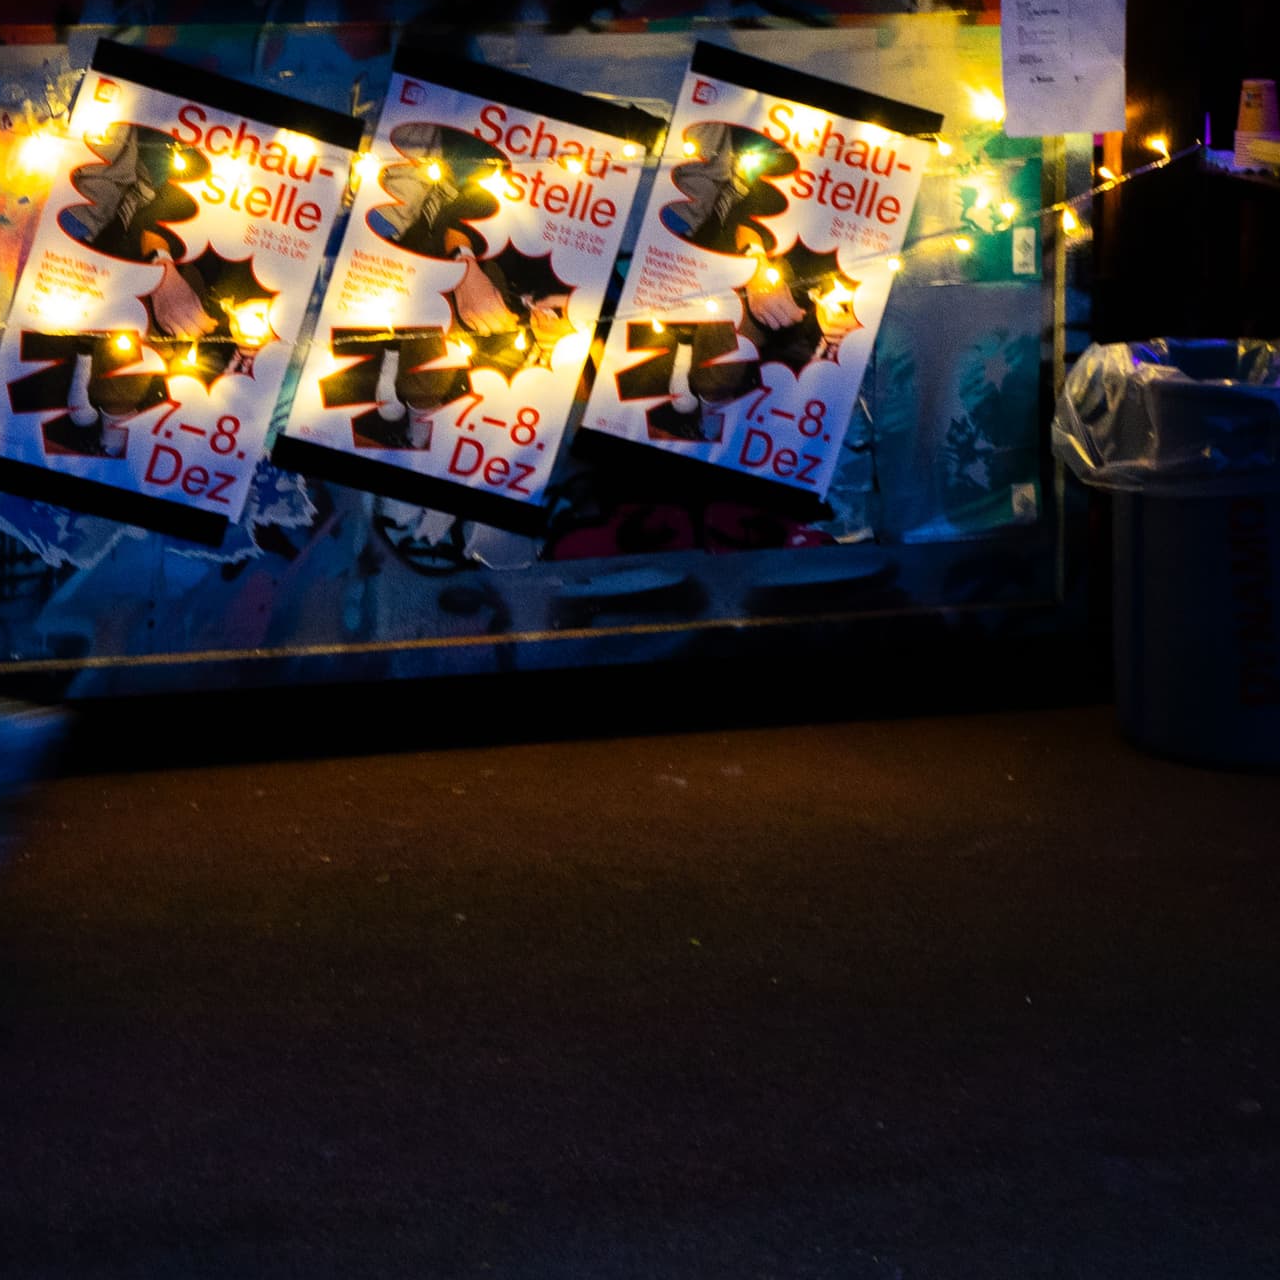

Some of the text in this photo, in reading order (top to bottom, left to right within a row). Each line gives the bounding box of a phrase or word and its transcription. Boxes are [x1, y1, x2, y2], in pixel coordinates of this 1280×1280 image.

[171, 105, 335, 182] Schau-
[472, 105, 629, 179] Schau-
[762, 103, 913, 177] Schau-
[201, 173, 322, 233] stelle
[505, 169, 618, 229] stelle
[791, 167, 902, 225] stelle
[144, 445, 237, 505] Dez
[447, 435, 537, 496] Dez
[738, 428, 823, 486] Dez
